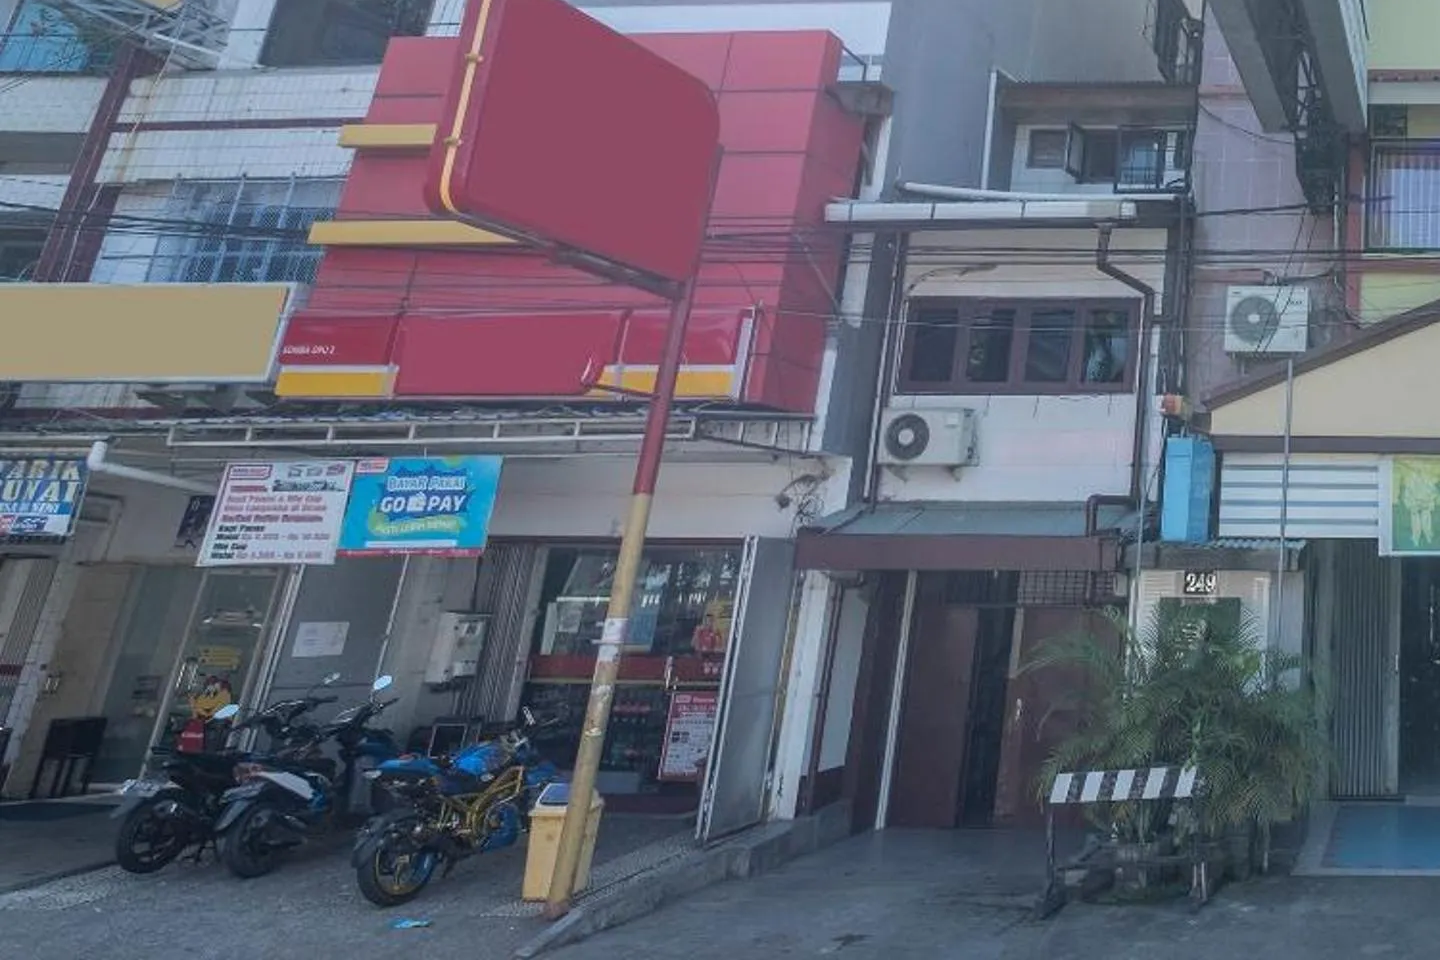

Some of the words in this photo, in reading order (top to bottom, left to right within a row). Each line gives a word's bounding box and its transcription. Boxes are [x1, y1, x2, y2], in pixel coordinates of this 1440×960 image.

[380, 494, 407, 512] GO
[427, 494, 467, 512] PAY
[1186, 572, 1217, 593] 249
